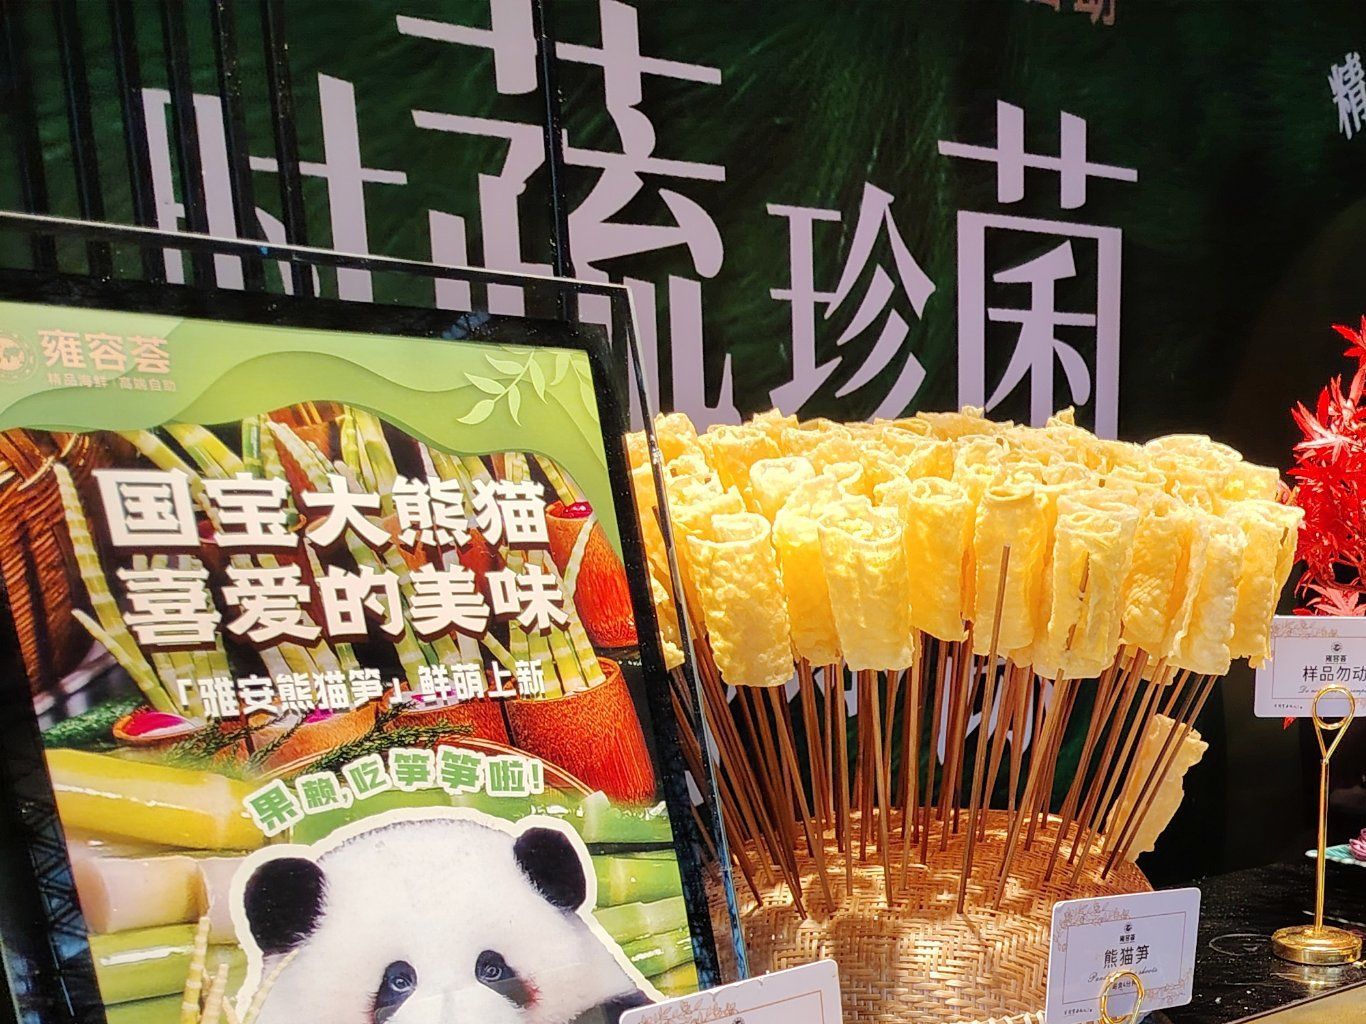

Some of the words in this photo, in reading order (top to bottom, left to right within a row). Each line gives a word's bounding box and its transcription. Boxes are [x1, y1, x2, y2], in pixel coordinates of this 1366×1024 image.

[38, 329, 170, 374] 雍容荟
[93, 468, 551, 549] 国宝大熊猫
[117, 562, 570, 647] 喜爱的美味
[1104, 944, 1150, 969] 熊猫笋
